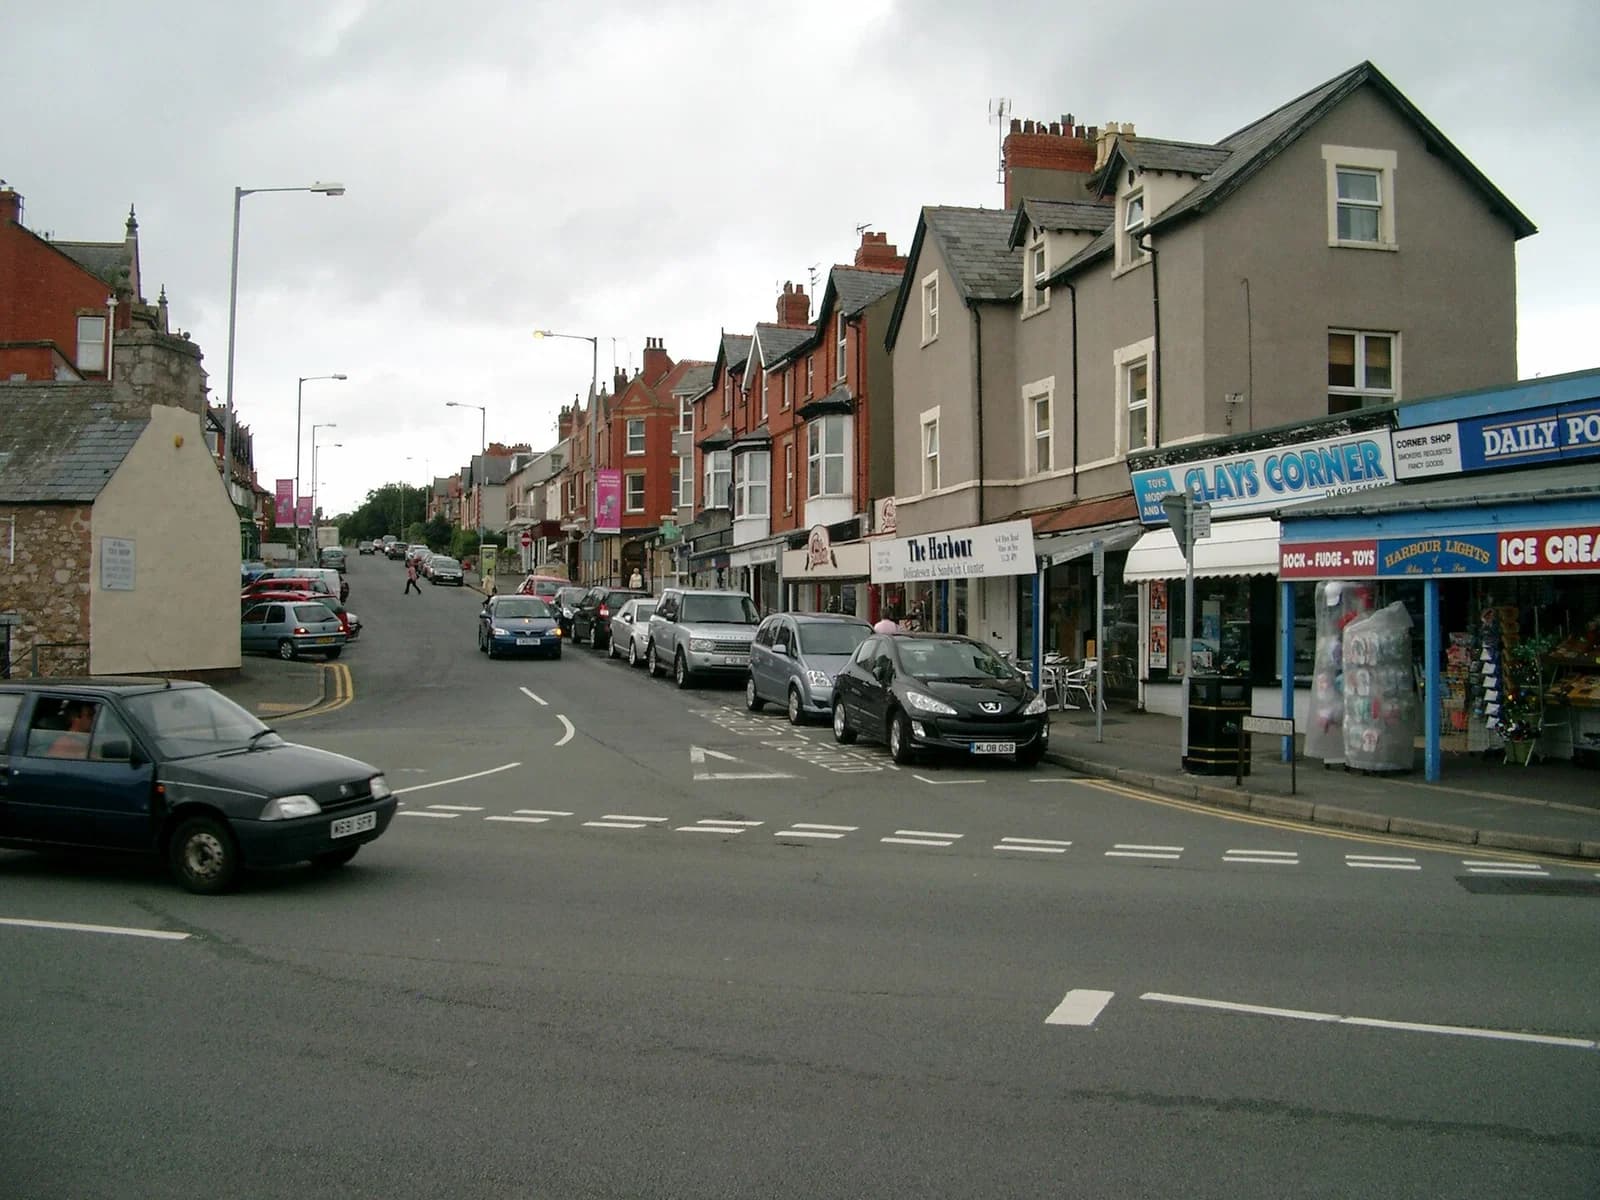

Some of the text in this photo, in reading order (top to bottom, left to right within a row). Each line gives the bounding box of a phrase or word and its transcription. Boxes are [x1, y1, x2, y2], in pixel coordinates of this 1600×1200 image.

[1396, 433, 1451, 449] CORNER SHOP
[1483, 415, 1600, 456] DAILY PO
[1147, 478, 1168, 489] TOYS
[1184, 440, 1388, 504] CLAYS CORNER
[1143, 506, 1160, 517] AND
[907, 539, 926, 562] The
[928, 535, 973, 561] Harbour
[1283, 552, 1306, 568] ROCK
[1315, 551, 1342, 567] FUDGE
[1352, 550, 1376, 566] TOYS
[1384, 540, 1490, 568] HARBOUR LIGHTS
[1501, 537, 1537, 566] ICE
